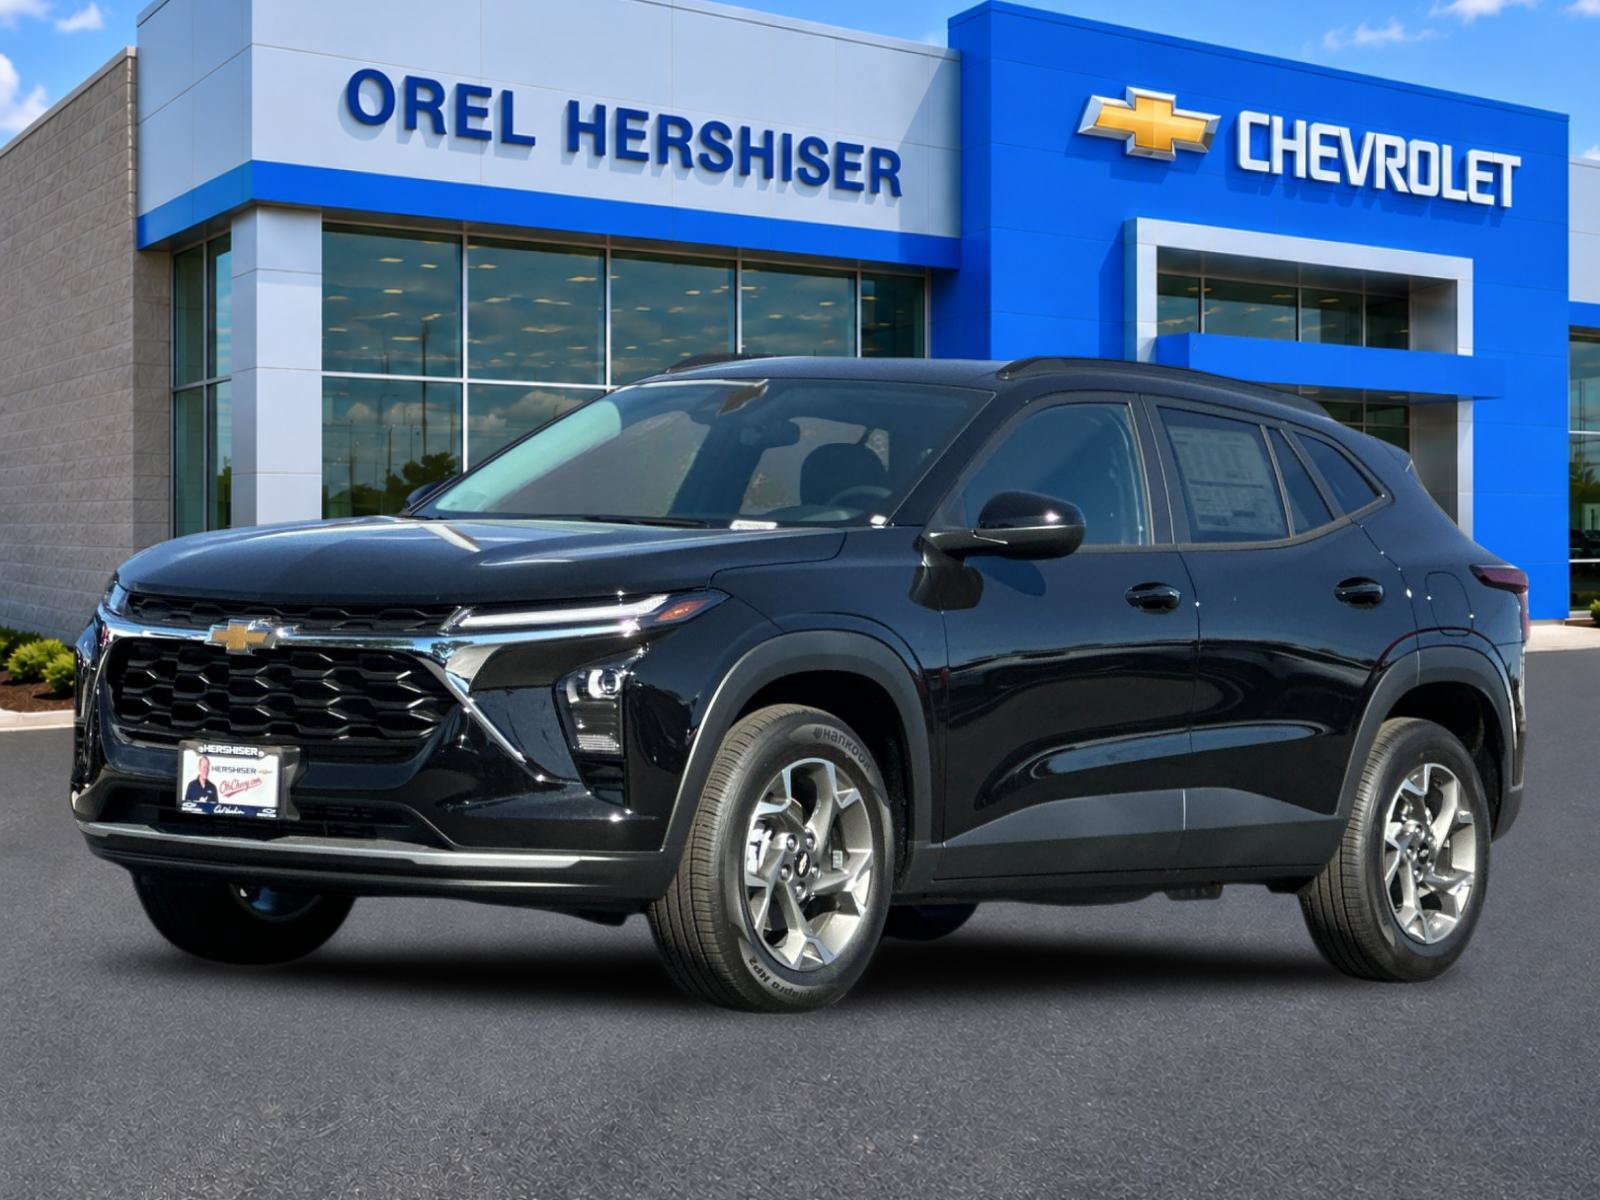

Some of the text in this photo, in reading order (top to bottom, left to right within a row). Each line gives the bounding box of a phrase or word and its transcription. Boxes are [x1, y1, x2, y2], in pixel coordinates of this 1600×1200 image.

[346, 68, 903, 198] OREL HERSHISER
[1236, 110, 1522, 208] CHEVROLET
[203, 744, 258, 756] HERSHISER
[211, 765, 257, 775] HERSHISER
